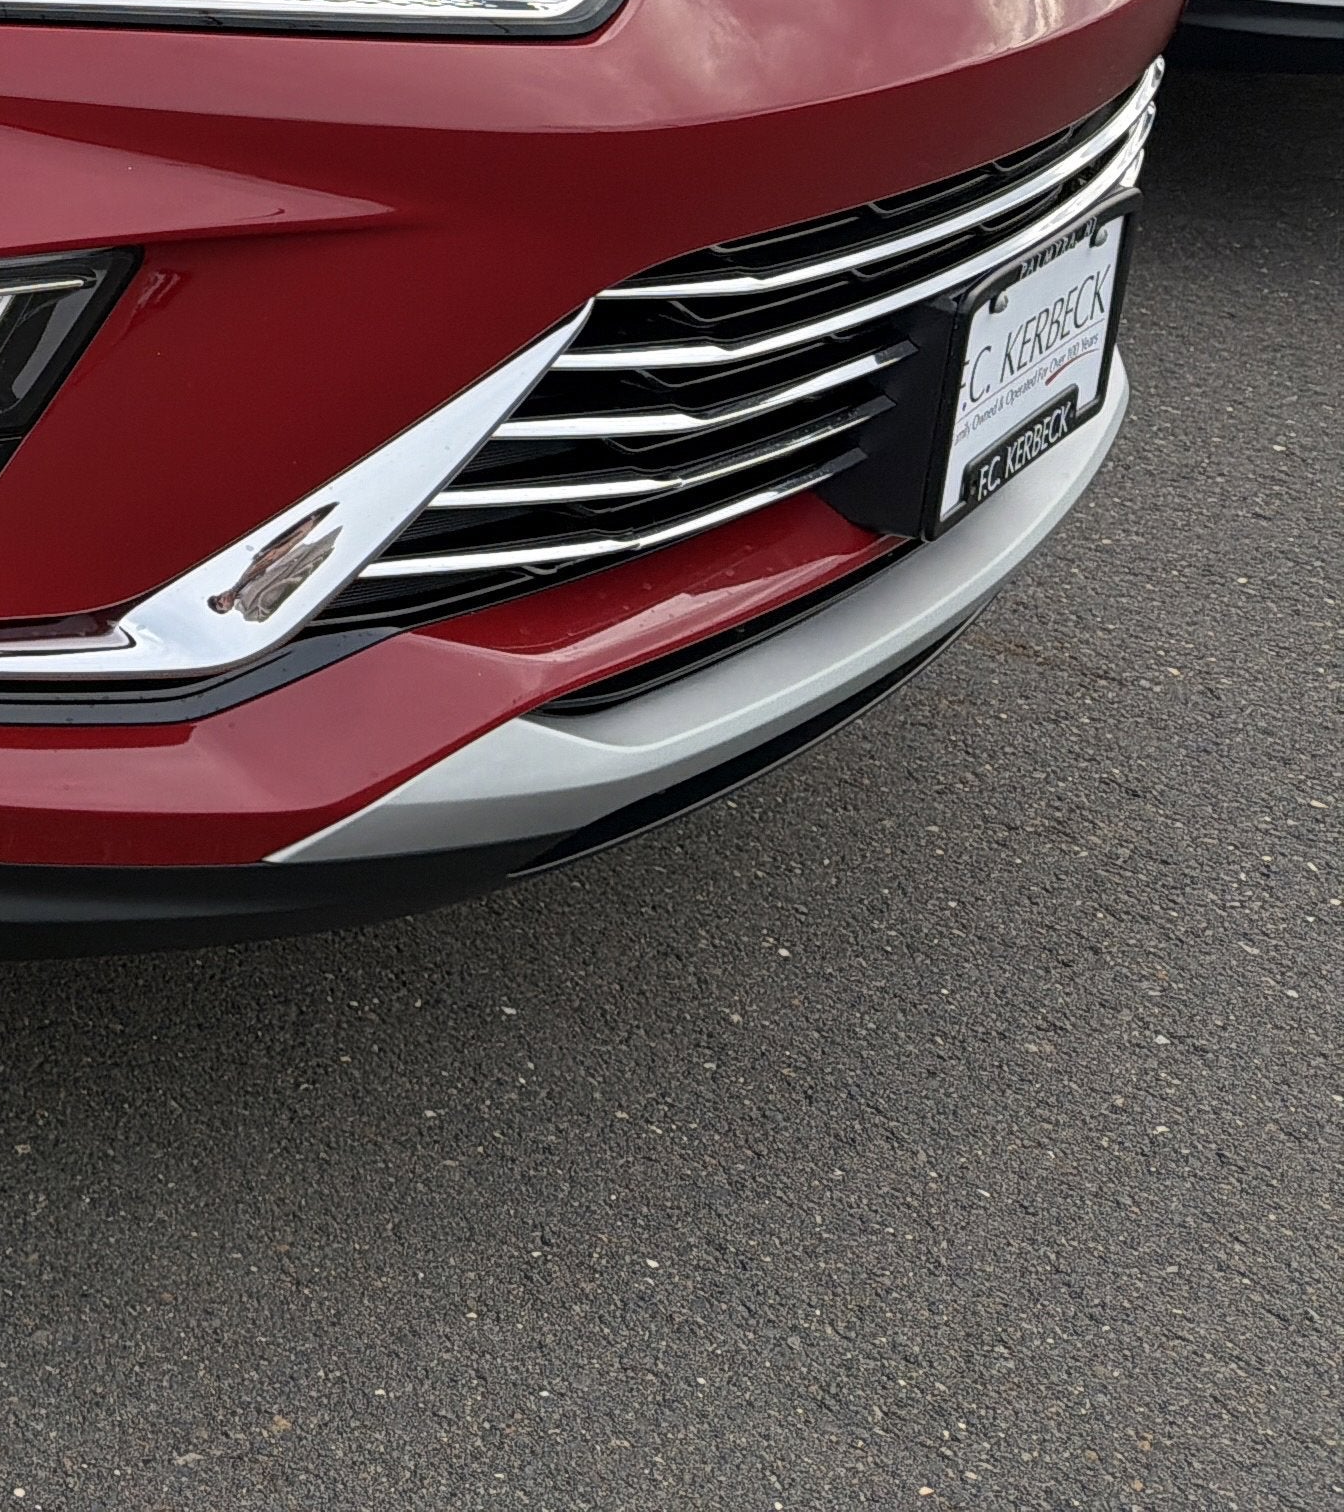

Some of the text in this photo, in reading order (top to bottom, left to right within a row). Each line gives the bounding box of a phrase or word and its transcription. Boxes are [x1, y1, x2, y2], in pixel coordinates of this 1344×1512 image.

[999, 263, 1112, 384] KERBECK
[1005, 371, 1039, 406] Operated
[1004, 400, 1072, 480] KERBECK
